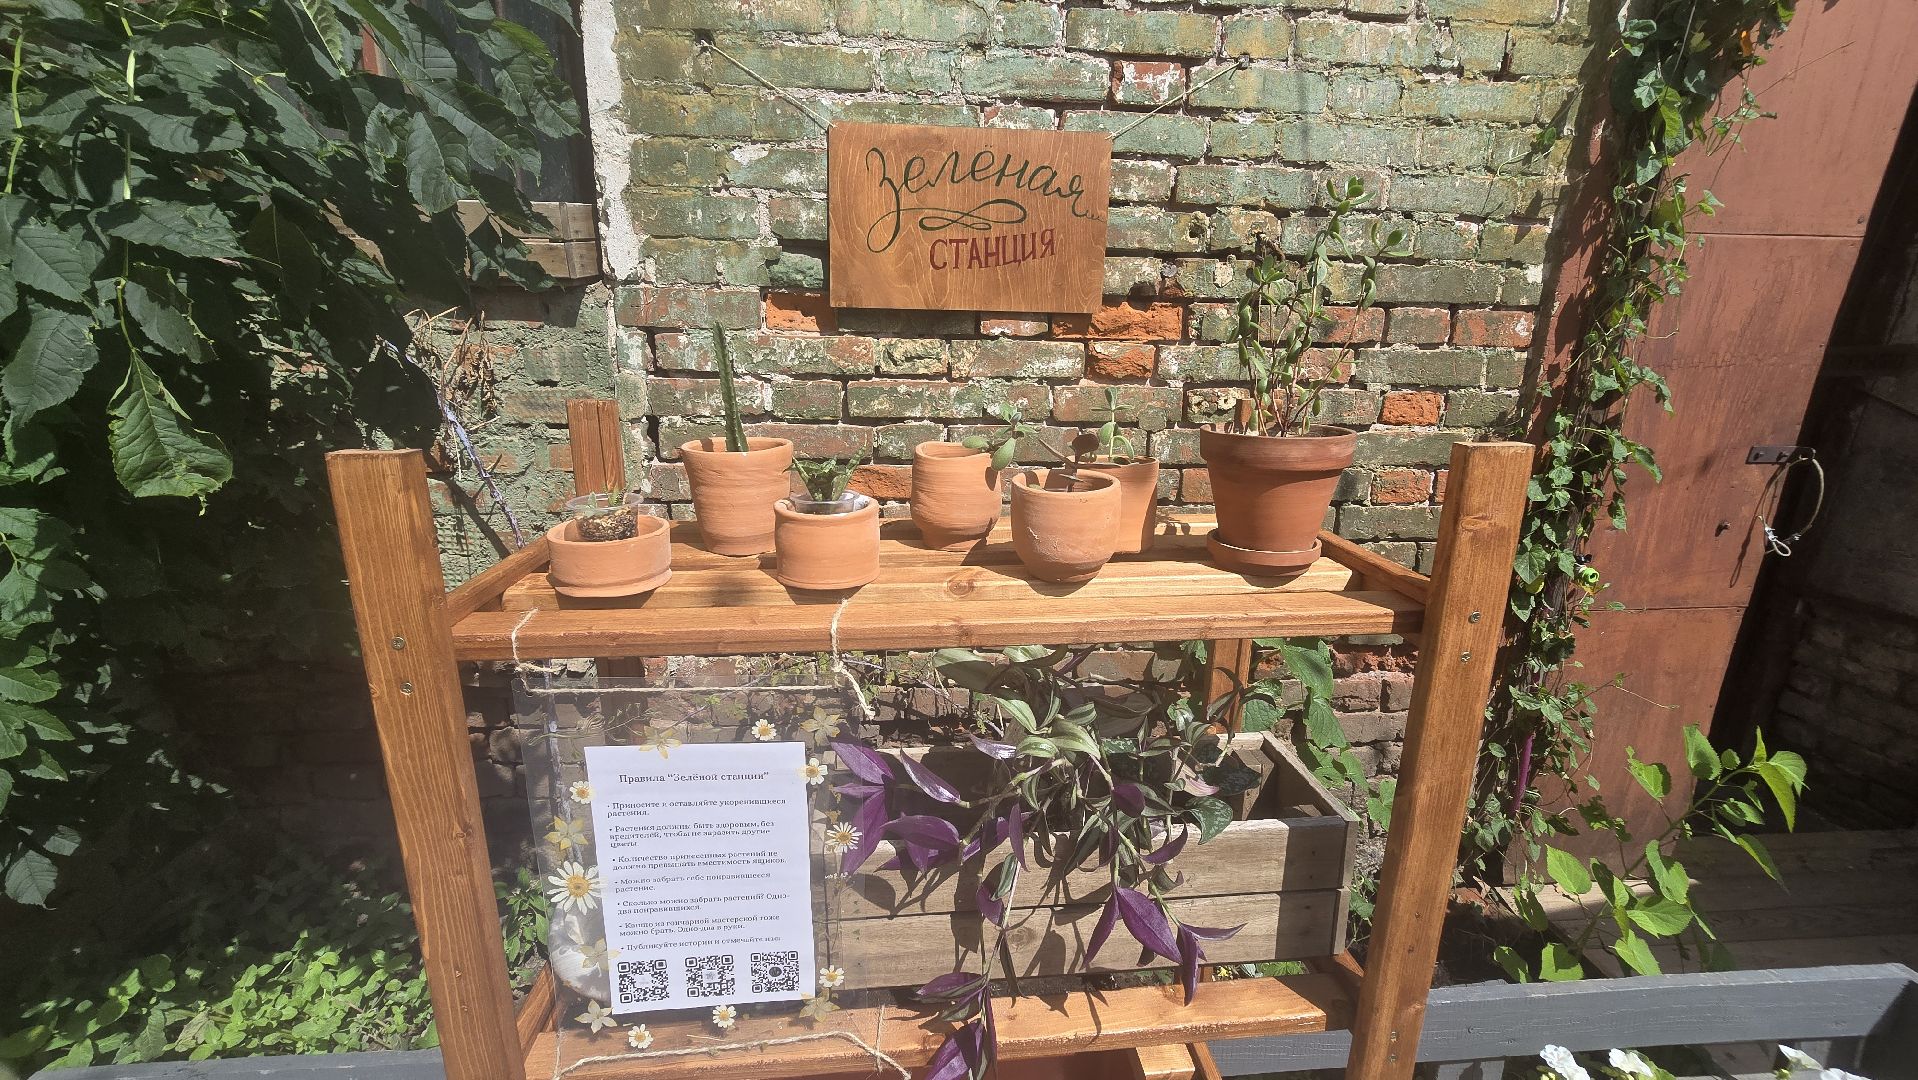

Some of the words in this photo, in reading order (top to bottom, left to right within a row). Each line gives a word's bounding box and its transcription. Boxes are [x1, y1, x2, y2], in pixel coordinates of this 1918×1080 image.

[866, 145, 1104, 254] Зелёная
[929, 229, 1056, 270] СТАНЦИЯ
[619, 774, 666, 785] Правила
[613, 801, 660, 810] Приносите
[719, 798, 786, 807] укоренившиеся
[607, 810, 650, 818] растения.
[656, 823, 691, 831] должны
[694, 822, 713, 830] быть
[610, 831, 662, 840] вредителей,
[703, 829, 740, 837] заразить
[741, 828, 771, 837] другие
[618, 855, 668, 863] Количество
[728, 850, 766, 859] растений
[613, 862, 647, 871] должно
[648, 861, 696, 870] превышать
[697, 858, 751, 867] вместимость
[752, 857, 786, 865] ящиков.
[653, 875, 685, 884] забрать
[706, 872, 771, 881] понравившееся
[615, 885, 655, 894] растение.
[690, 895, 722, 905] забрать
[723, 893, 764, 902] растений?
[617, 908, 632, 916] два
[633, 904, 702, 915] понравившихся.
[625, 921, 654, 929] Кашпо
[666, 917, 709, 927] гончарной
[711, 915, 758, 925] мастерской
[619, 929, 649, 937] можно
[650, 926, 676, 936] брать.
[722, 924, 745, 932] руки.
[627, 941, 678, 952] Публикуйте
[679, 939, 713, 948] истории
[721, 936, 763, 945] отмечайте
